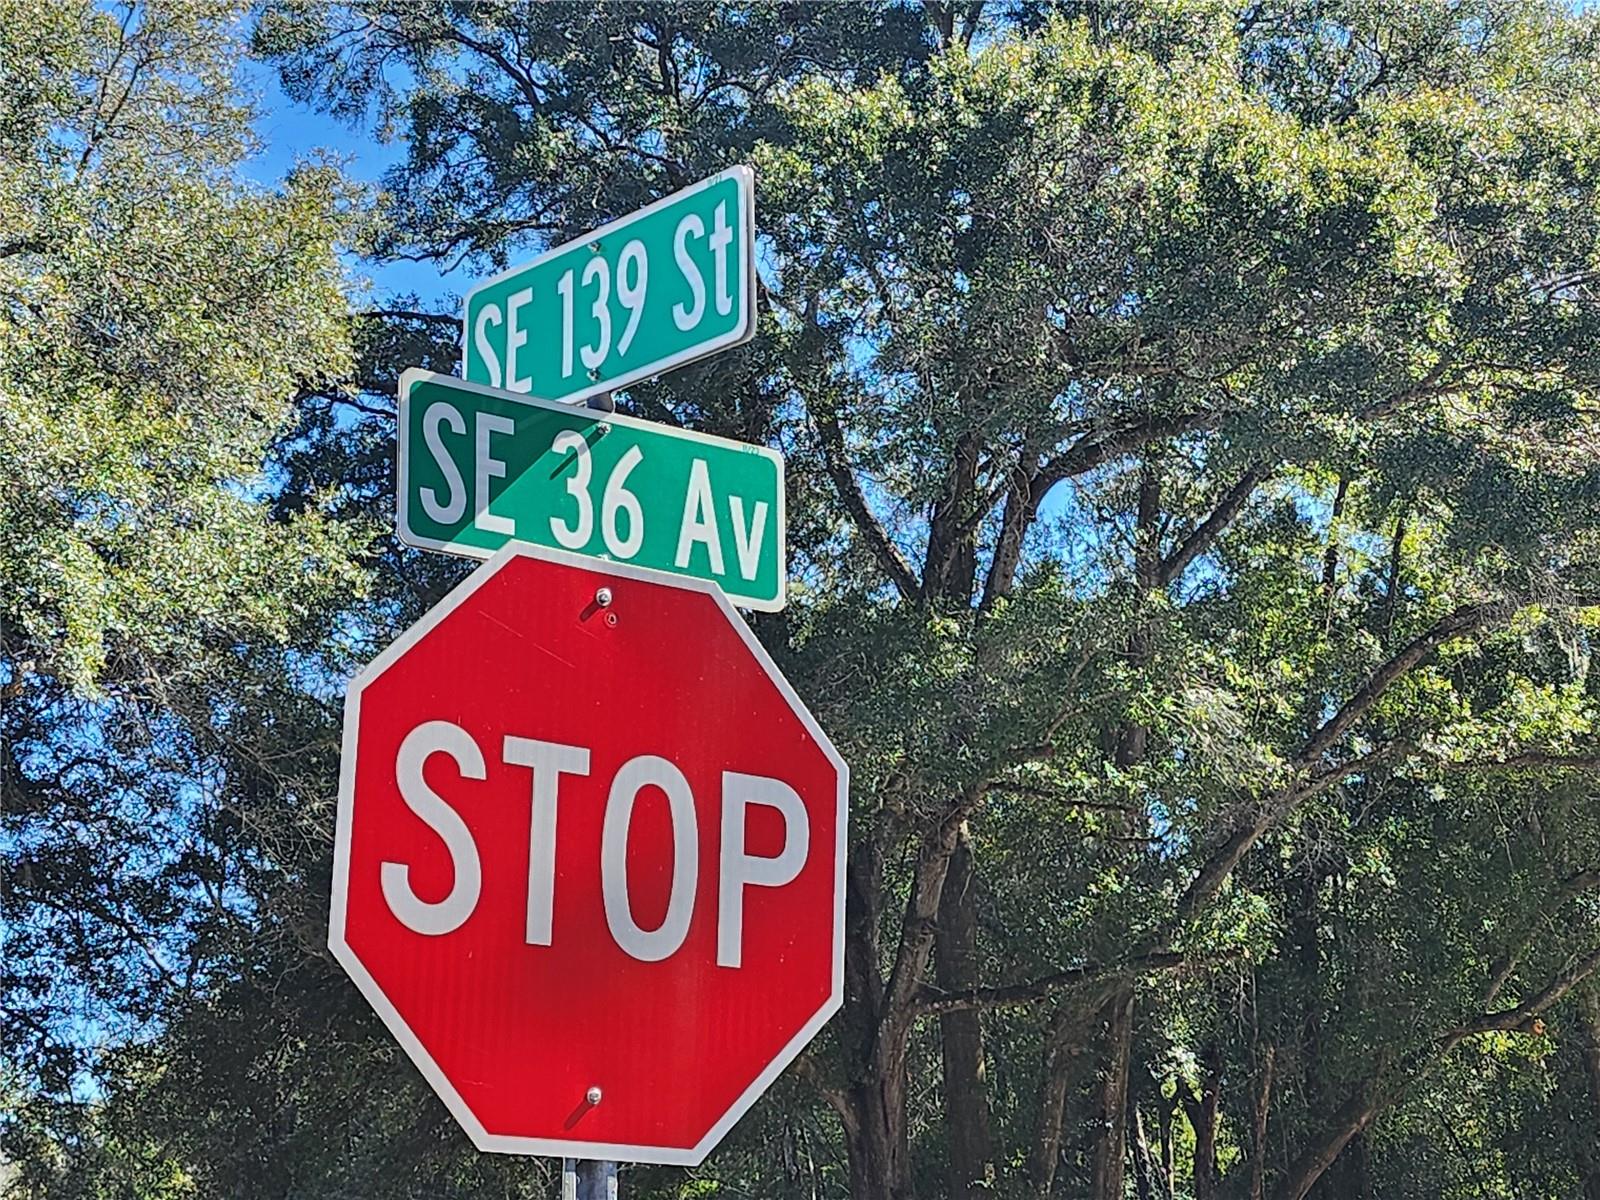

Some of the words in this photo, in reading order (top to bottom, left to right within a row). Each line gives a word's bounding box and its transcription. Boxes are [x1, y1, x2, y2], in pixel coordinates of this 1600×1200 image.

[474, 287, 533, 394] SE
[557, 239, 648, 379] 139
[672, 200, 733, 332] St
[419, 401, 516, 536] SE
[549, 429, 645, 559] 36
[674, 458, 768, 581] Av
[380, 720, 810, 969] STOP
